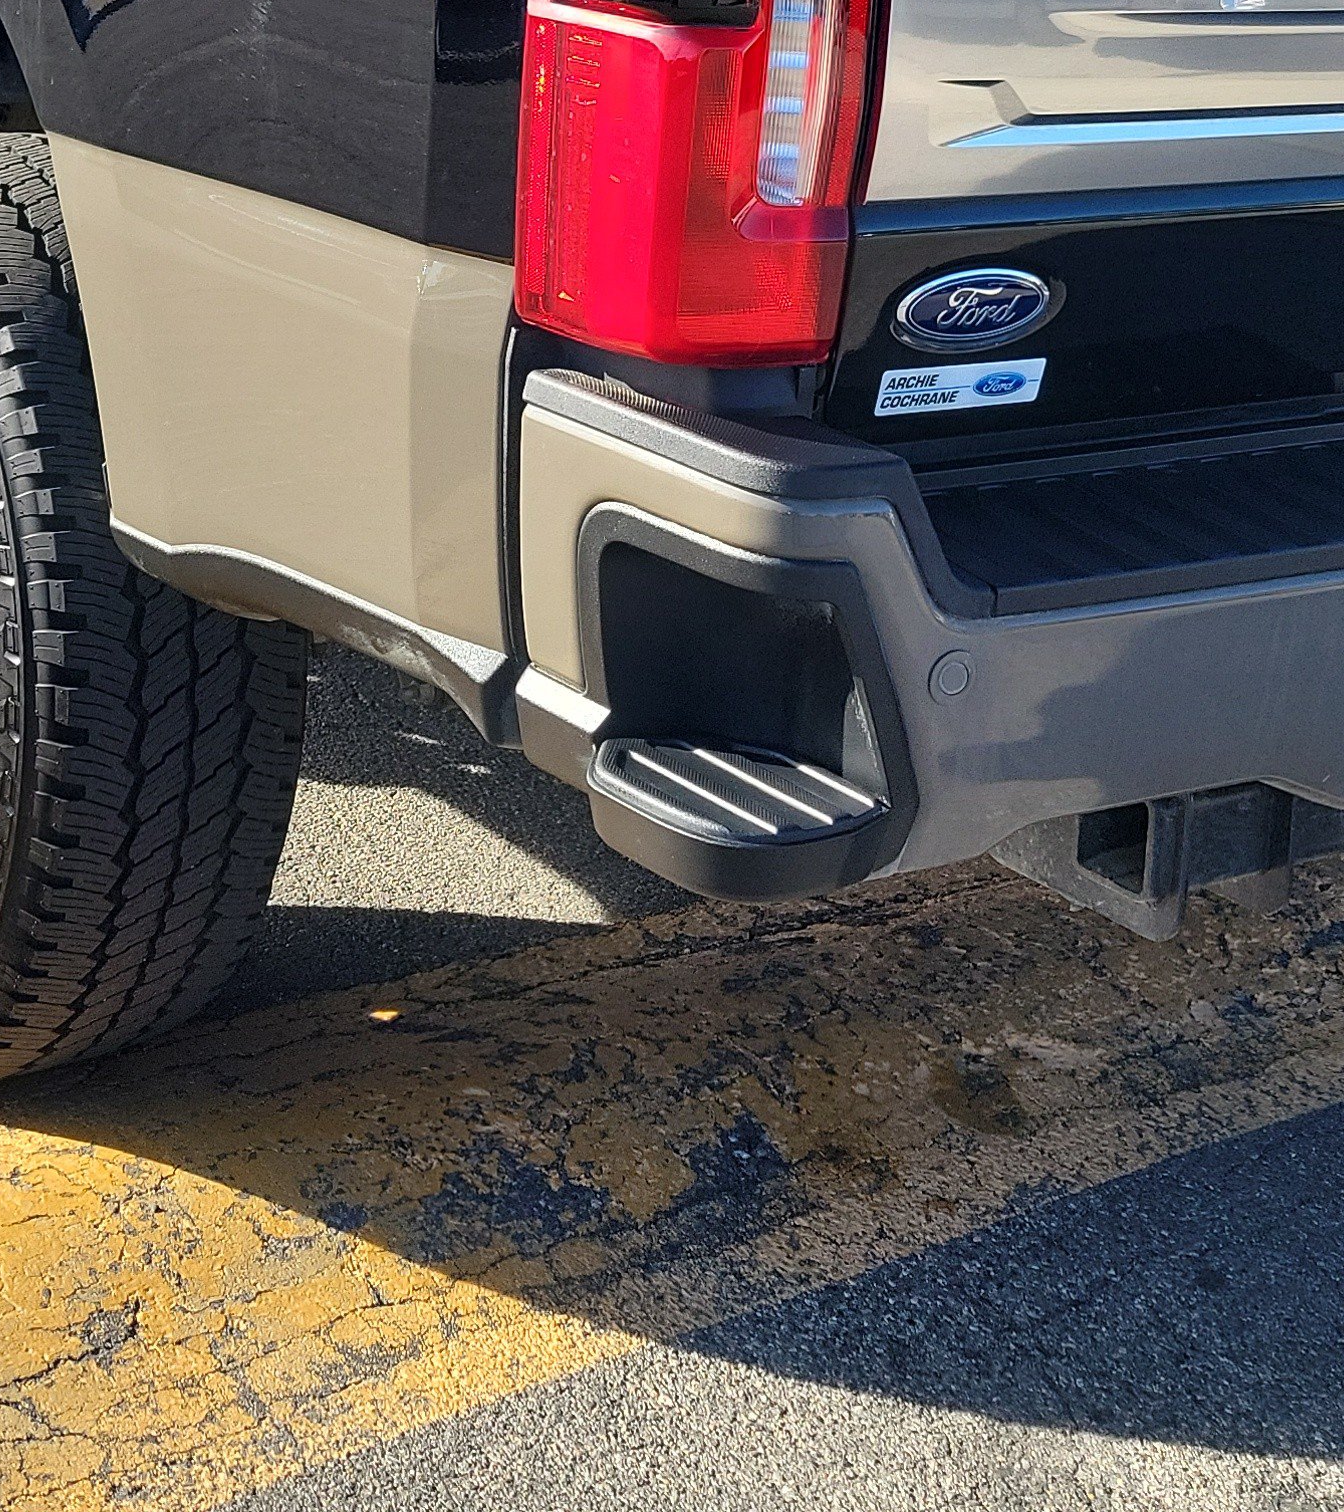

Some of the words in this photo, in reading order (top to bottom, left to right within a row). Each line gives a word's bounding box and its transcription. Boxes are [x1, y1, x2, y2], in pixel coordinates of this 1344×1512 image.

[936, 286, 1022, 327] Ford
[885, 374, 940, 391] ARCHIE
[982, 375, 1017, 393] Ford
[879, 390, 960, 409] COCHRANE
